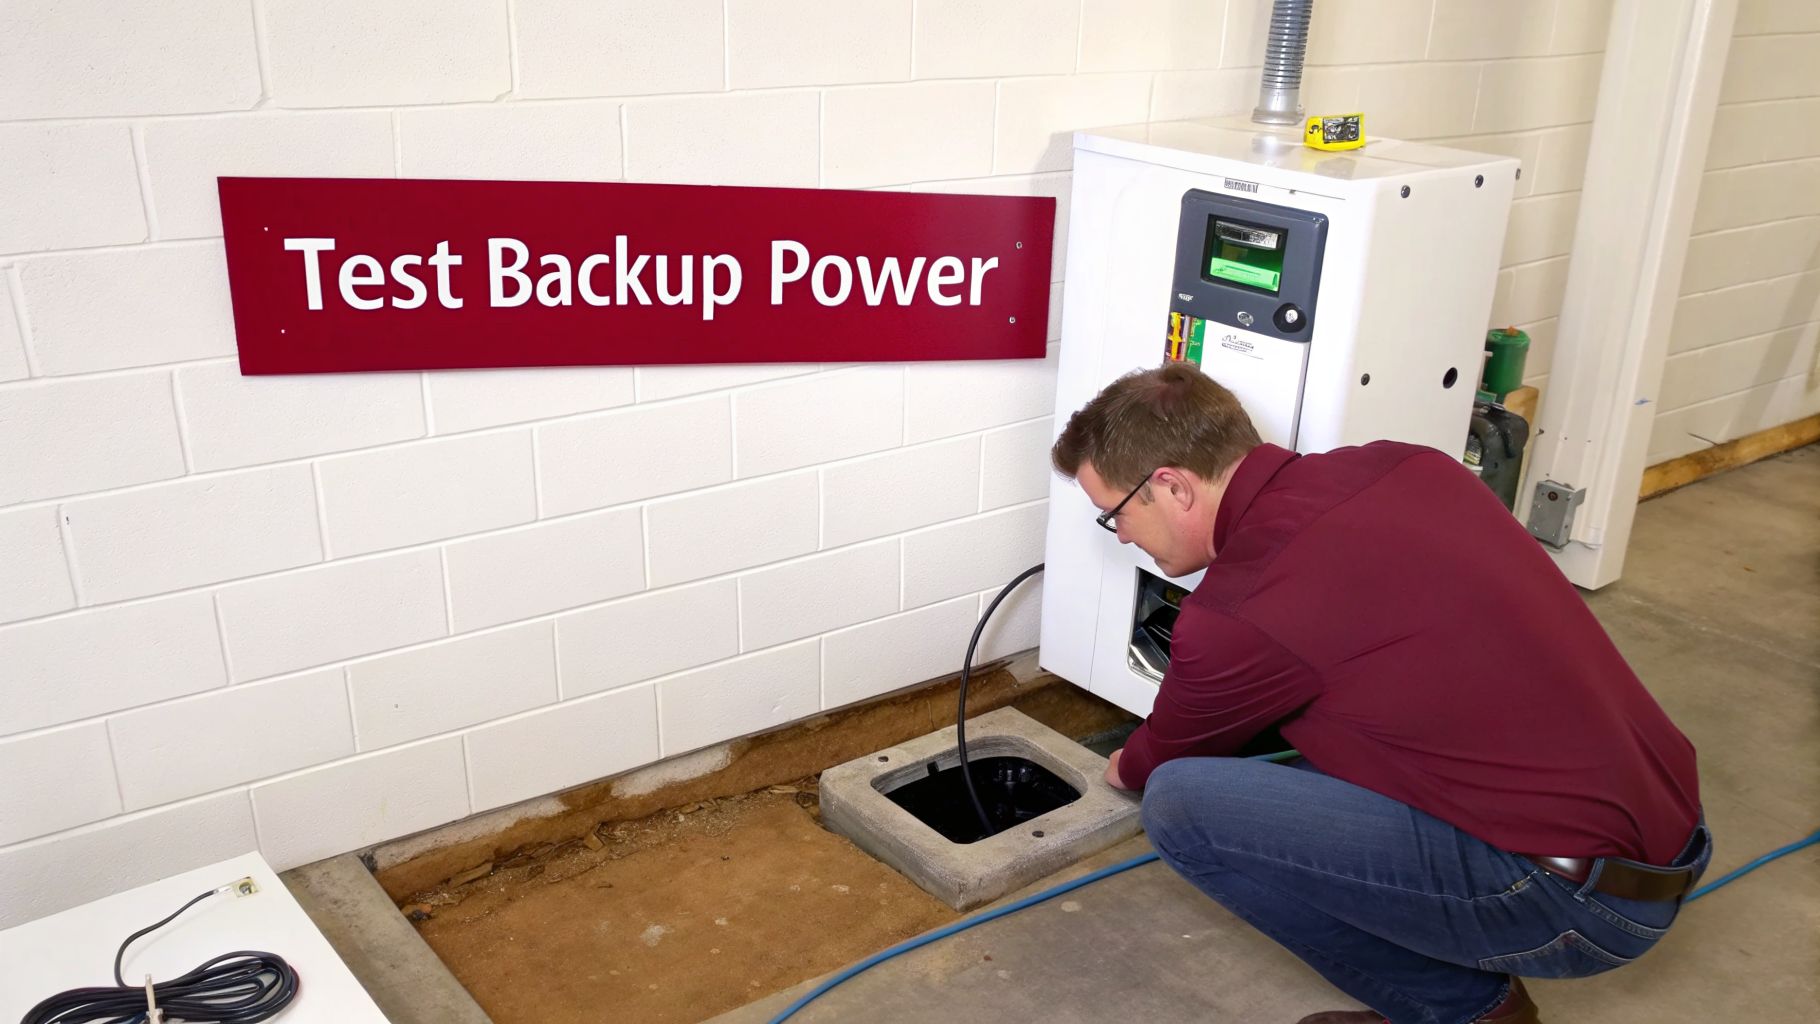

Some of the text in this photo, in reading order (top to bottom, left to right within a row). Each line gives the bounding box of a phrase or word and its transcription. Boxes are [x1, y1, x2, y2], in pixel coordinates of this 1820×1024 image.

[283, 235, 999, 320] Test Backup Power
